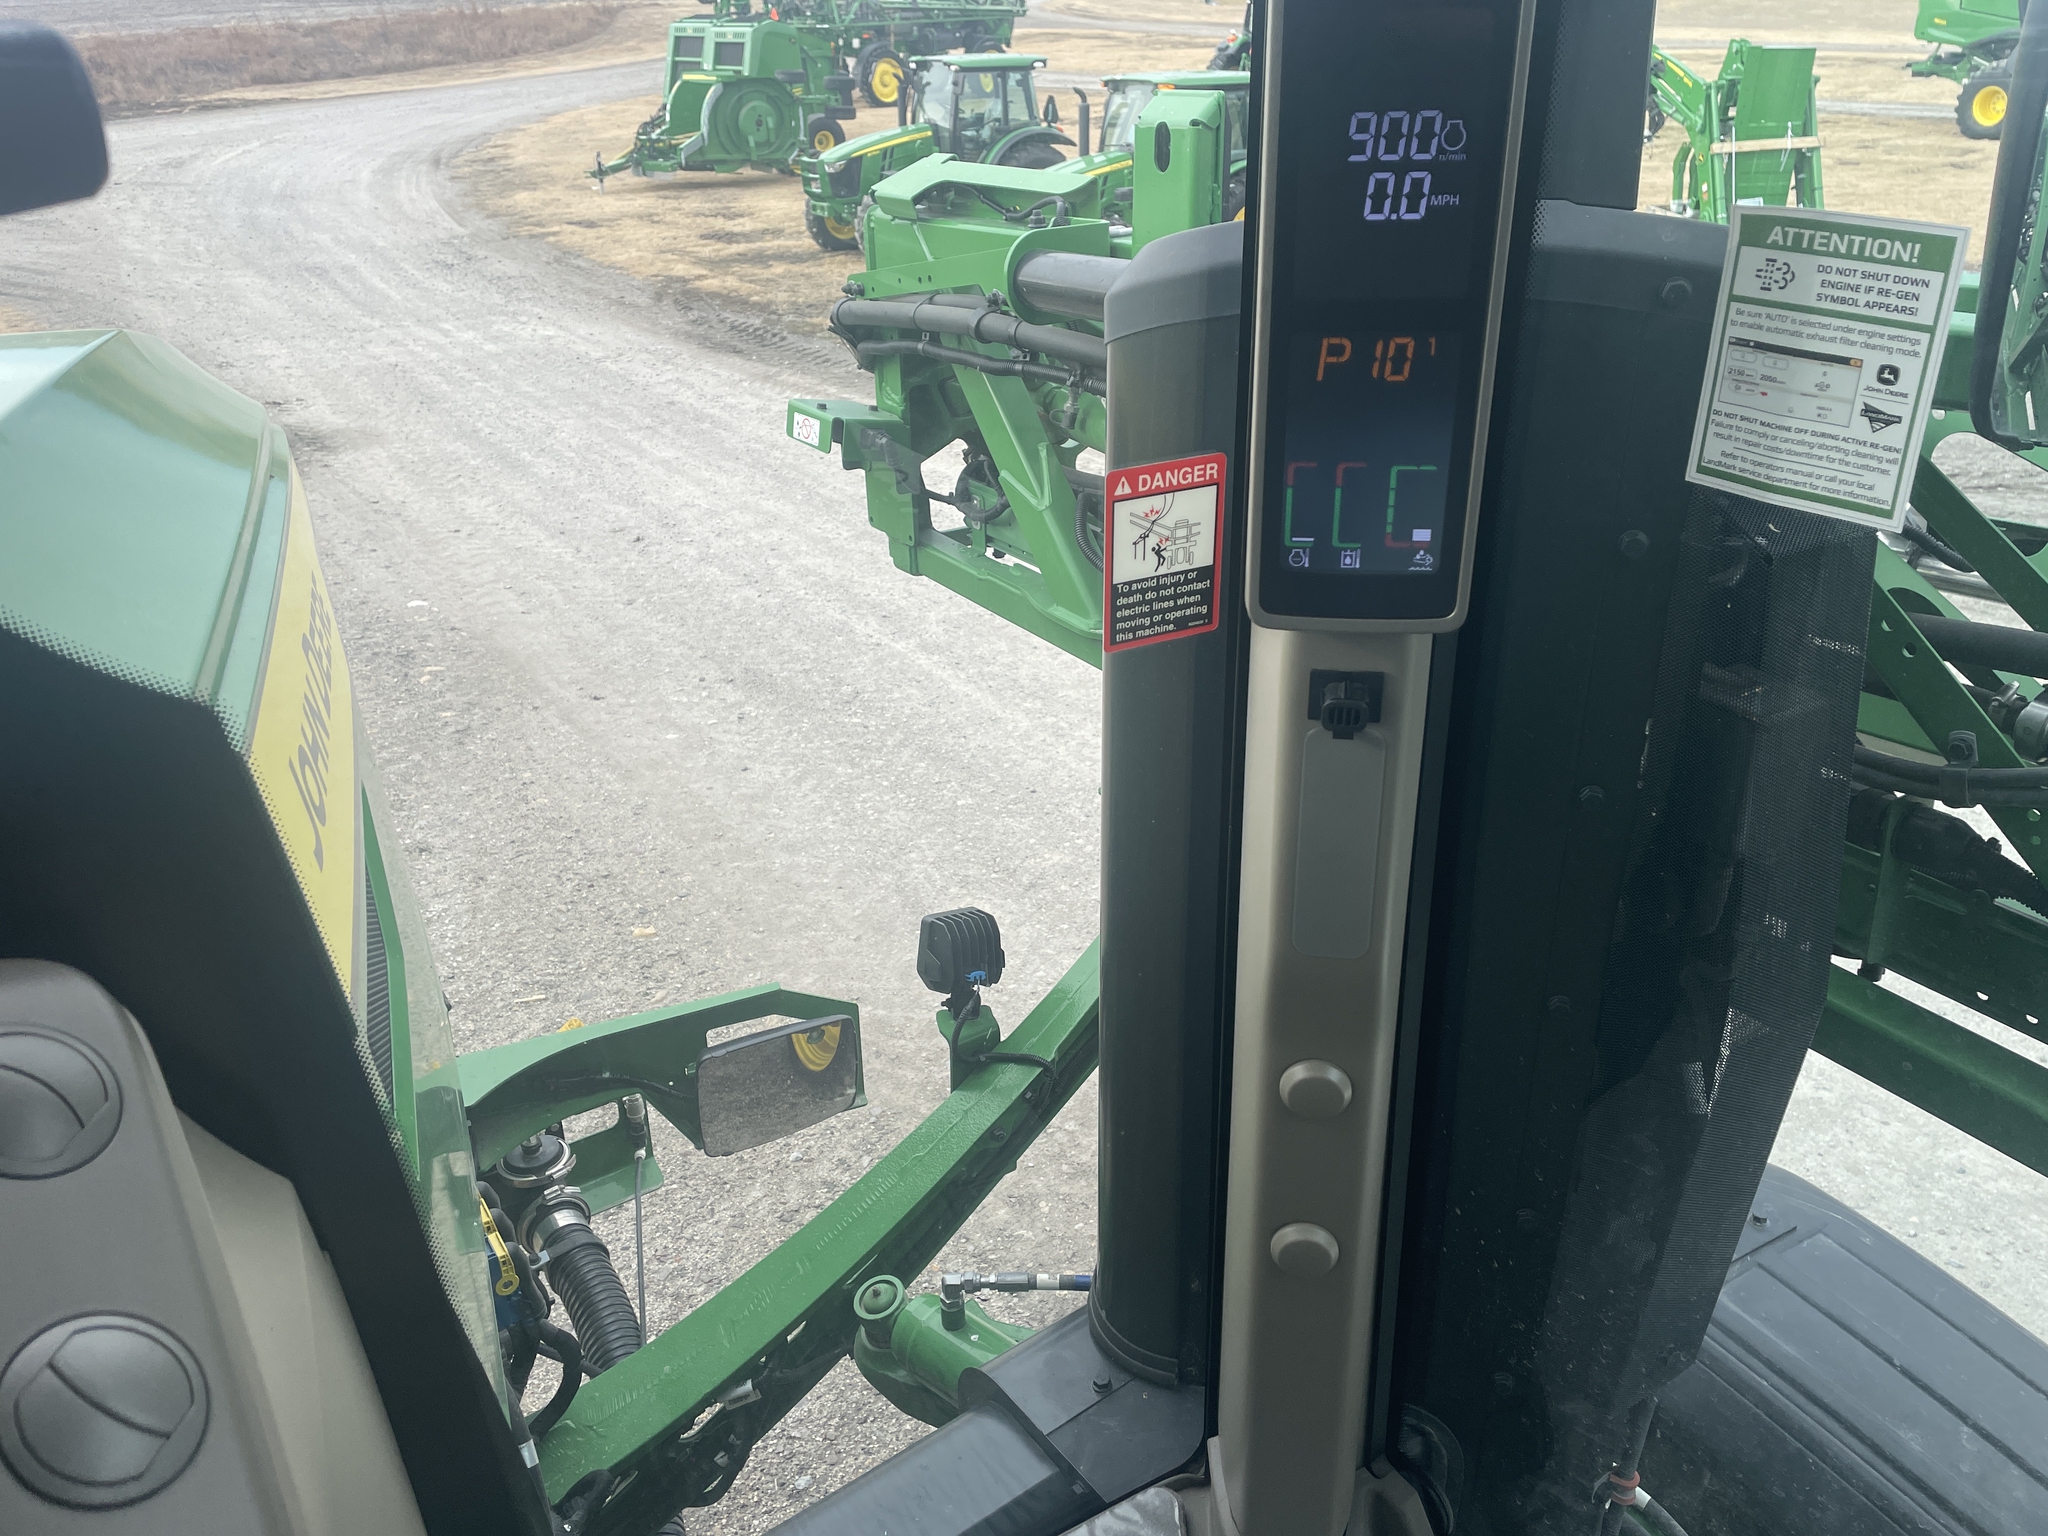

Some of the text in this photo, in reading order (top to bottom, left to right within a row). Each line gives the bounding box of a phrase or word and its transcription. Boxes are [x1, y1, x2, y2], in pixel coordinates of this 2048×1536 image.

[1347, 109, 1442, 161] 900
[1363, 171, 1432, 220] 0.0
[1430, 194, 1460, 205] MPH
[1766, 225, 1921, 263] ATTENTION!
[1817, 264, 1930, 288] DO NOT SHUT DOWN
[1820, 279, 1920, 301] ENGINE IF RE-GEN
[1816, 292, 1919, 316] SYMBOL APPEARS!
[1730, 319, 1921, 358] to enable automatic exhaust filter cleaning mode.
[1735, 307, 1745, 316] Be
[1747, 310, 1763, 319] sure
[1791, 316, 1797, 325] is
[1798, 318, 1832, 330] selected
[1833, 324, 1857, 334] under
[1857, 329, 1885, 340] engine
[1887, 333, 1921, 346] settings
[1316, 336, 1414, 381] P 10
[1863, 385, 1909, 399] JOHN DEERE
[1711, 419, 1734, 430] Failure
[1735, 424, 1743, 432] to
[1744, 427, 1770, 440] comply
[1780, 436, 1850, 457] canceling/aborting
[1851, 449, 1884, 464] cleaning
[1885, 457, 1900, 466] will
[1712, 409, 1902, 454] DO NOT SHUT MACHINE OFF DURING ACTIVE RE-GEN!
[1713, 431, 1733, 442] result
[1733, 435, 1740, 443] in
[1741, 437, 1762, 449] repair
[1763, 444, 1824, 462] costs/downtime
[1825, 454, 1838, 463] for
[1838, 457, 1851, 467] the
[1138, 462, 1218, 492] DANGER
[1702, 456, 1891, 507] LandMark service department for more information.
[1720, 450, 1740, 461] Refer
[1740, 455, 1748, 463] to
[1749, 459, 1785, 473] operators
[1785, 466, 1815, 478] manual
[1824, 474, 1838, 483] call
[1838, 478, 1856, 487] your
[1856, 480, 1875, 491] local
[1117, 571, 1198, 593] To avoid injury or
[1117, 579, 1211, 606] death do not contact
[1116, 593, 1201, 618] electric lines when
[1116, 603, 1208, 631] moving or operating
[1116, 623, 1177, 642] this machine.
[288, 569, 332, 873] JOHN DEERE
